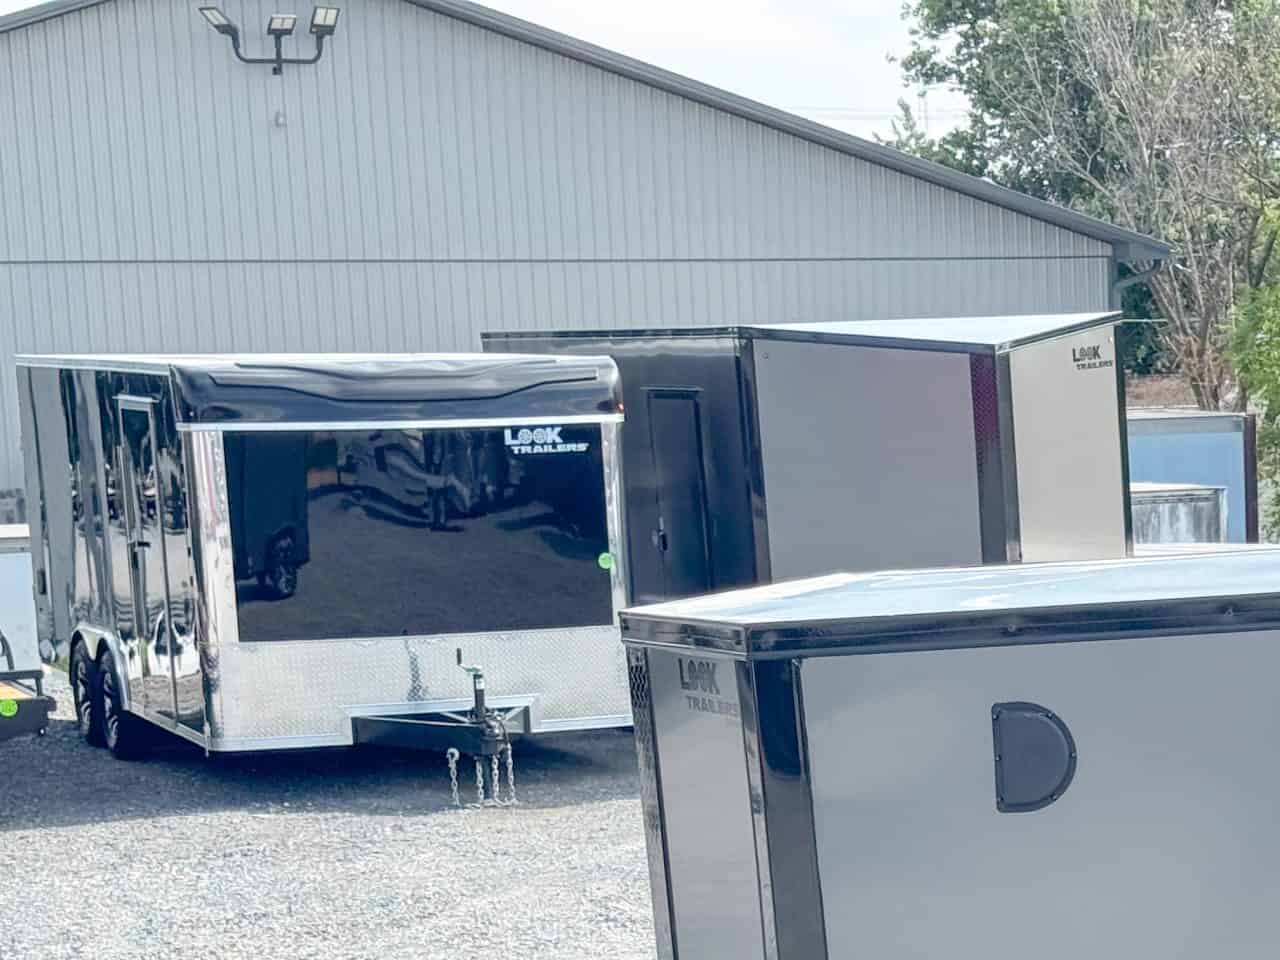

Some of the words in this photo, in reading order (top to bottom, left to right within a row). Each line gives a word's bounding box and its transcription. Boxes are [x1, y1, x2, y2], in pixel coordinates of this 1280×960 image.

[1072, 344, 1101, 362] LOOK
[503, 427, 563, 446] LOOK
[510, 442, 589, 454] TRAILERS
[677, 657, 720, 696] LOOK
